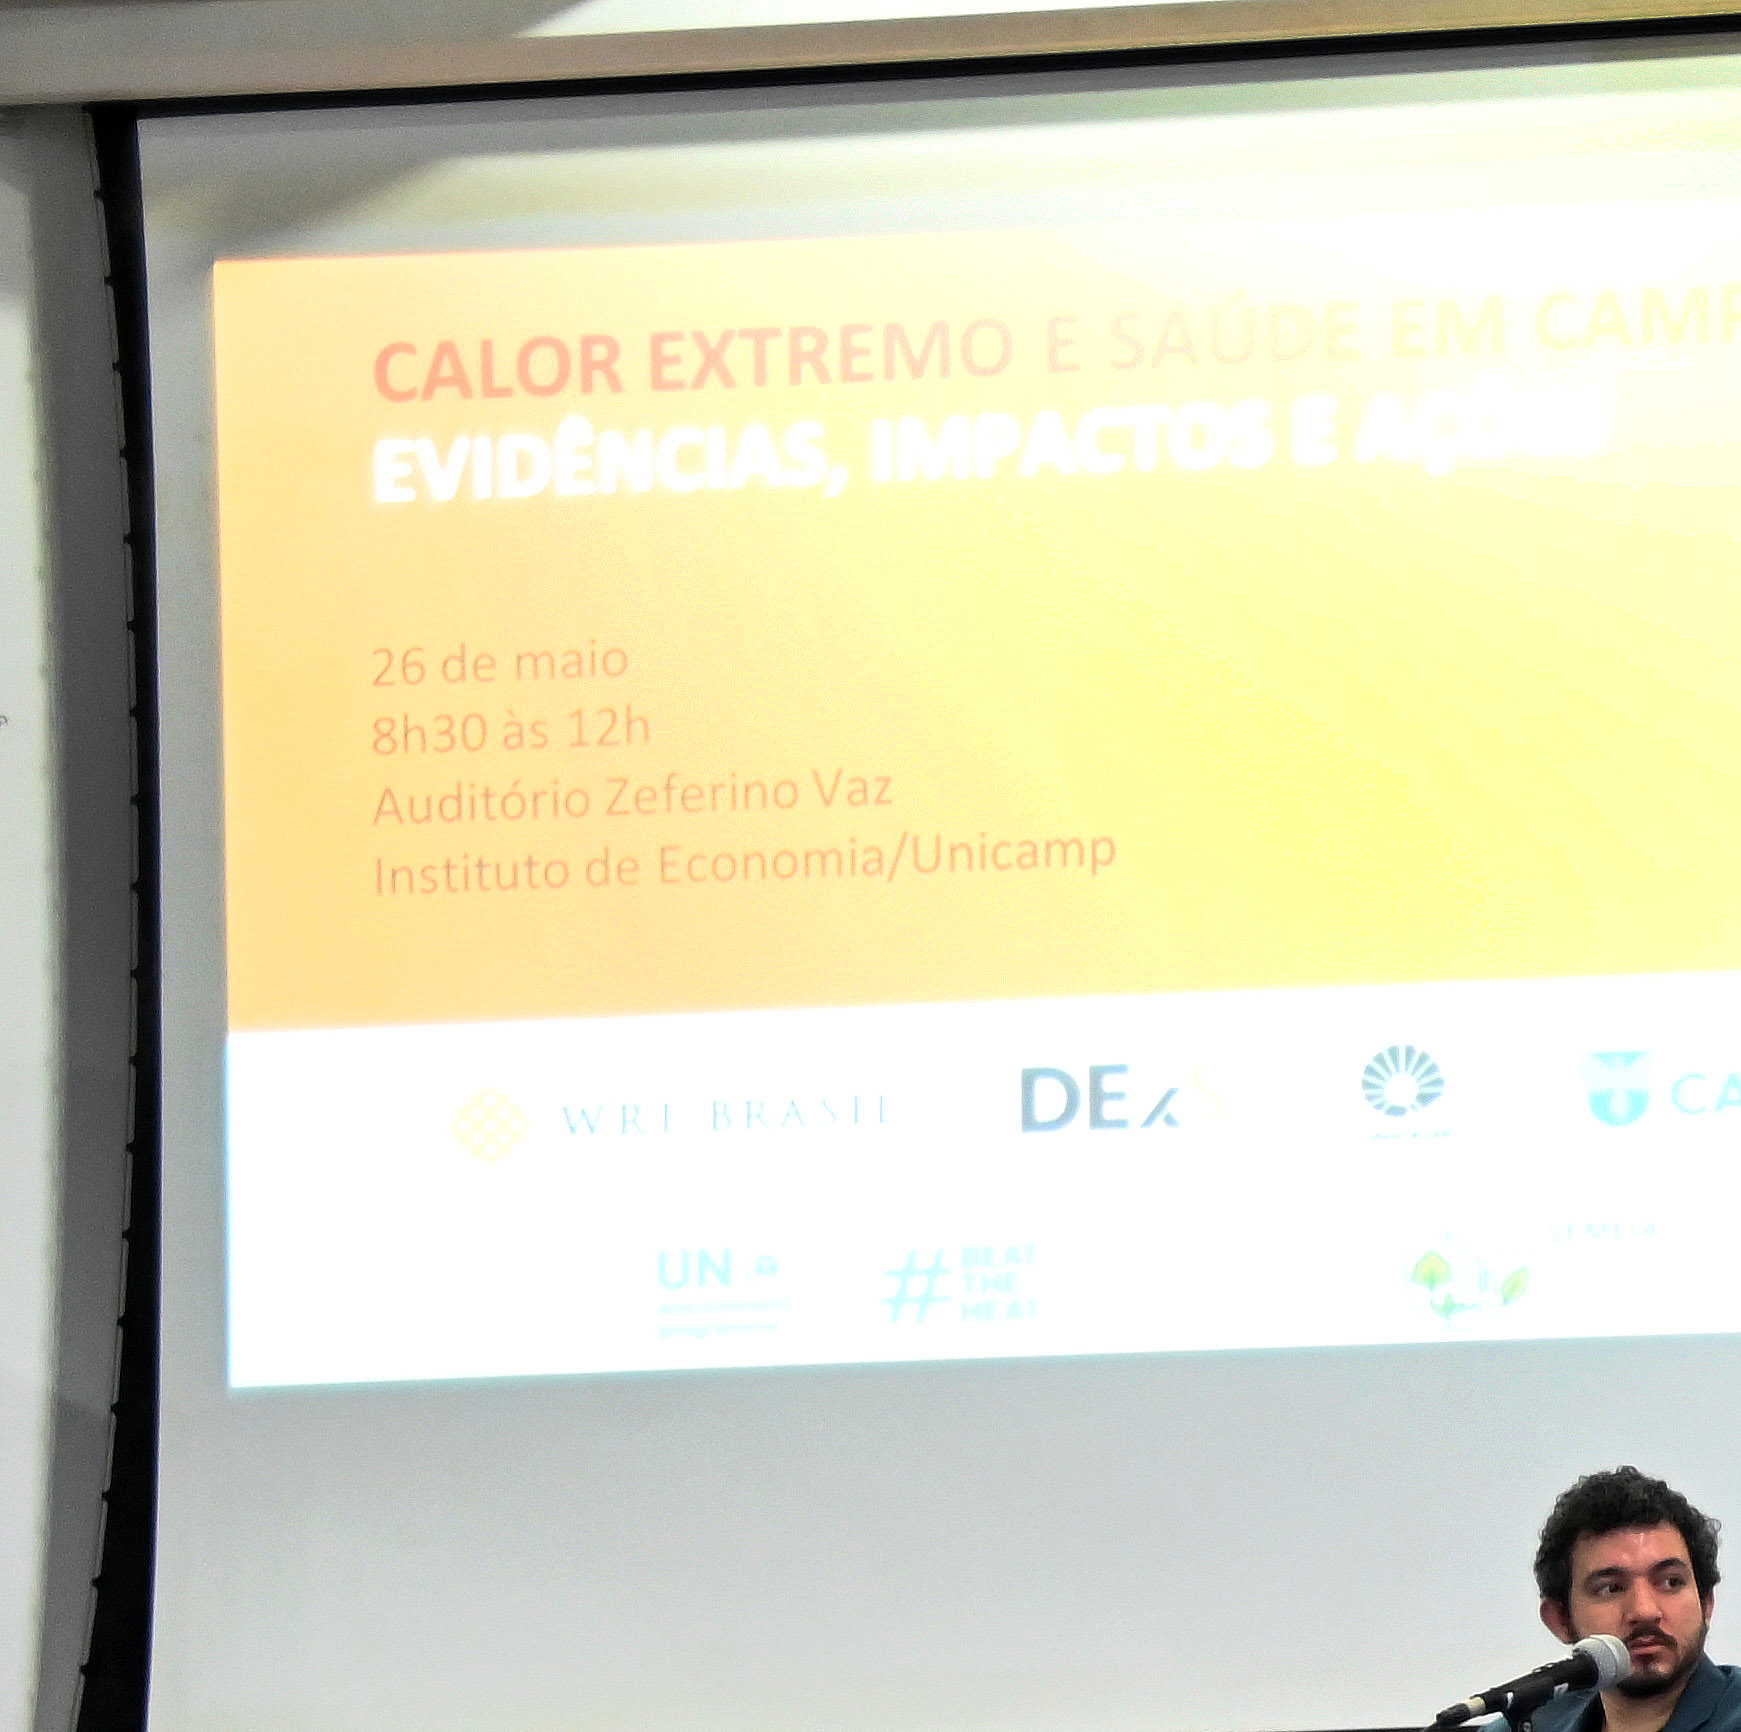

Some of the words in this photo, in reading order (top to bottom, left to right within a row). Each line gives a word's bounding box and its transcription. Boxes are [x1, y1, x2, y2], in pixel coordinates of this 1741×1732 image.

[374, 331, 625, 403] CALOR
[649, 316, 1014, 393] EXTREMO
[1047, 315, 1082, 374] E
[1110, 288, 1362, 371] SAÚDE
[373, 412, 848, 504] EVIDÊNCIAS,
[870, 400, 1275, 484] IMPACTOS
[1291, 392, 1339, 467] E
[1354, 374, 1614, 478] AÇÕ
[371, 647, 427, 687] 26
[441, 643, 498, 684] de
[515, 639, 630, 681] maio
[371, 711, 488, 756] 8h30
[502, 709, 549, 752] às
[569, 705, 651, 748] 12h
[372, 780, 591, 827] Auditório
[605, 771, 800, 818] Zeferino
[812, 768, 893, 808] Vaz
[373, 851, 570, 896] Instituto
[585, 847, 640, 887] de
[659, 830, 1117, 885] Economia/Unicamp
[562, 1102, 674, 1136] WRI
[711, 1092, 893, 1132] BRASIL
[656, 1247, 733, 1291] UN
